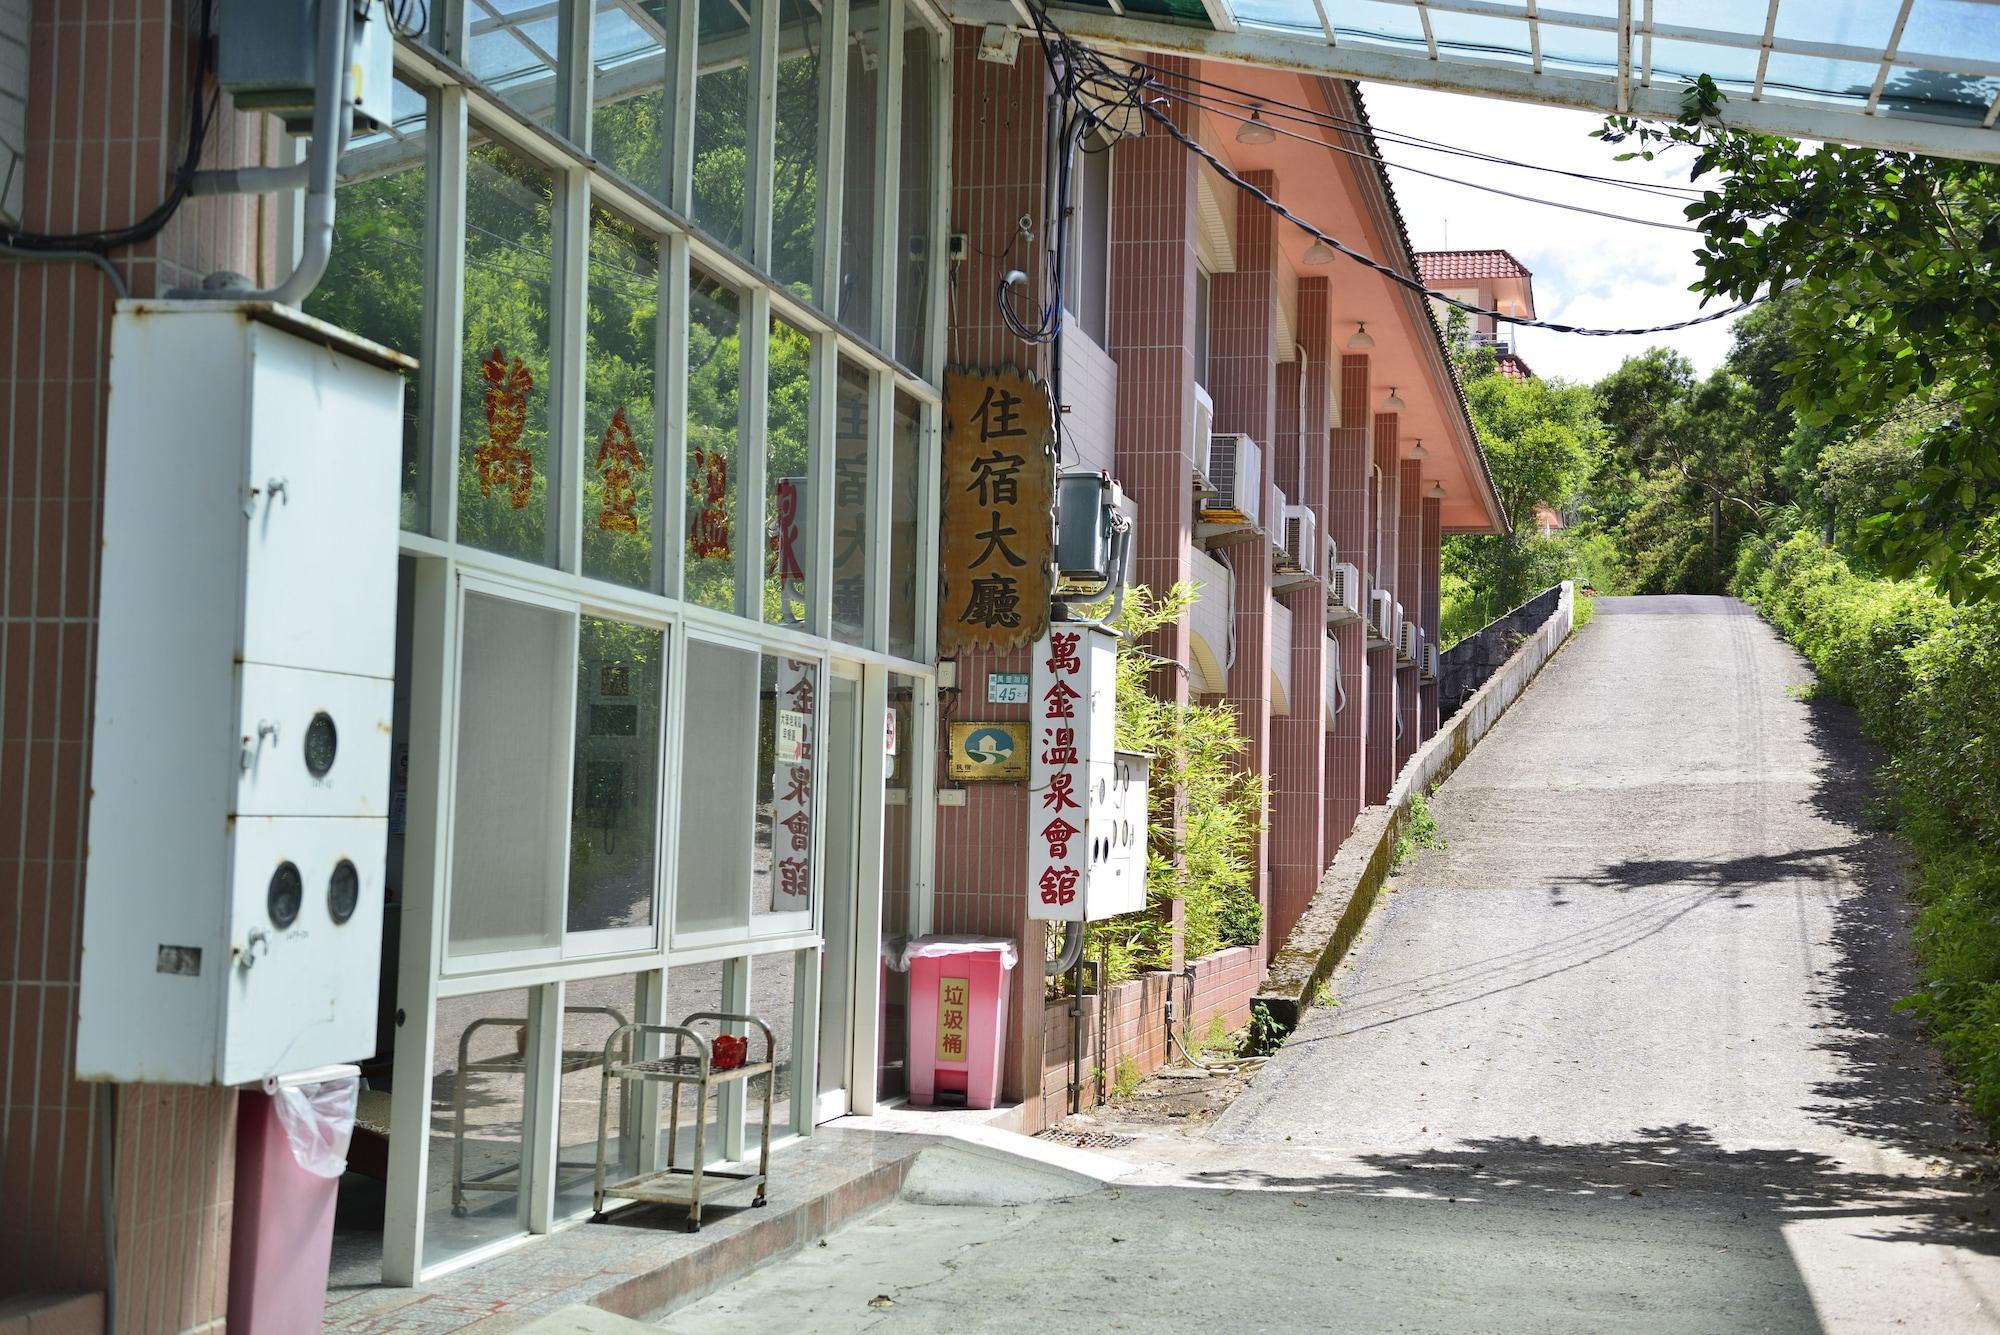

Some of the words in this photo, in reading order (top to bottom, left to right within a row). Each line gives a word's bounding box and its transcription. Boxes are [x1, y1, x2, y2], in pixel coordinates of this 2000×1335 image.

[958, 386, 1027, 628] 住宿大廳
[1038, 631, 1082, 907] 萬金溫泉會館
[942, 985, 964, 1054] 垃圾桶
